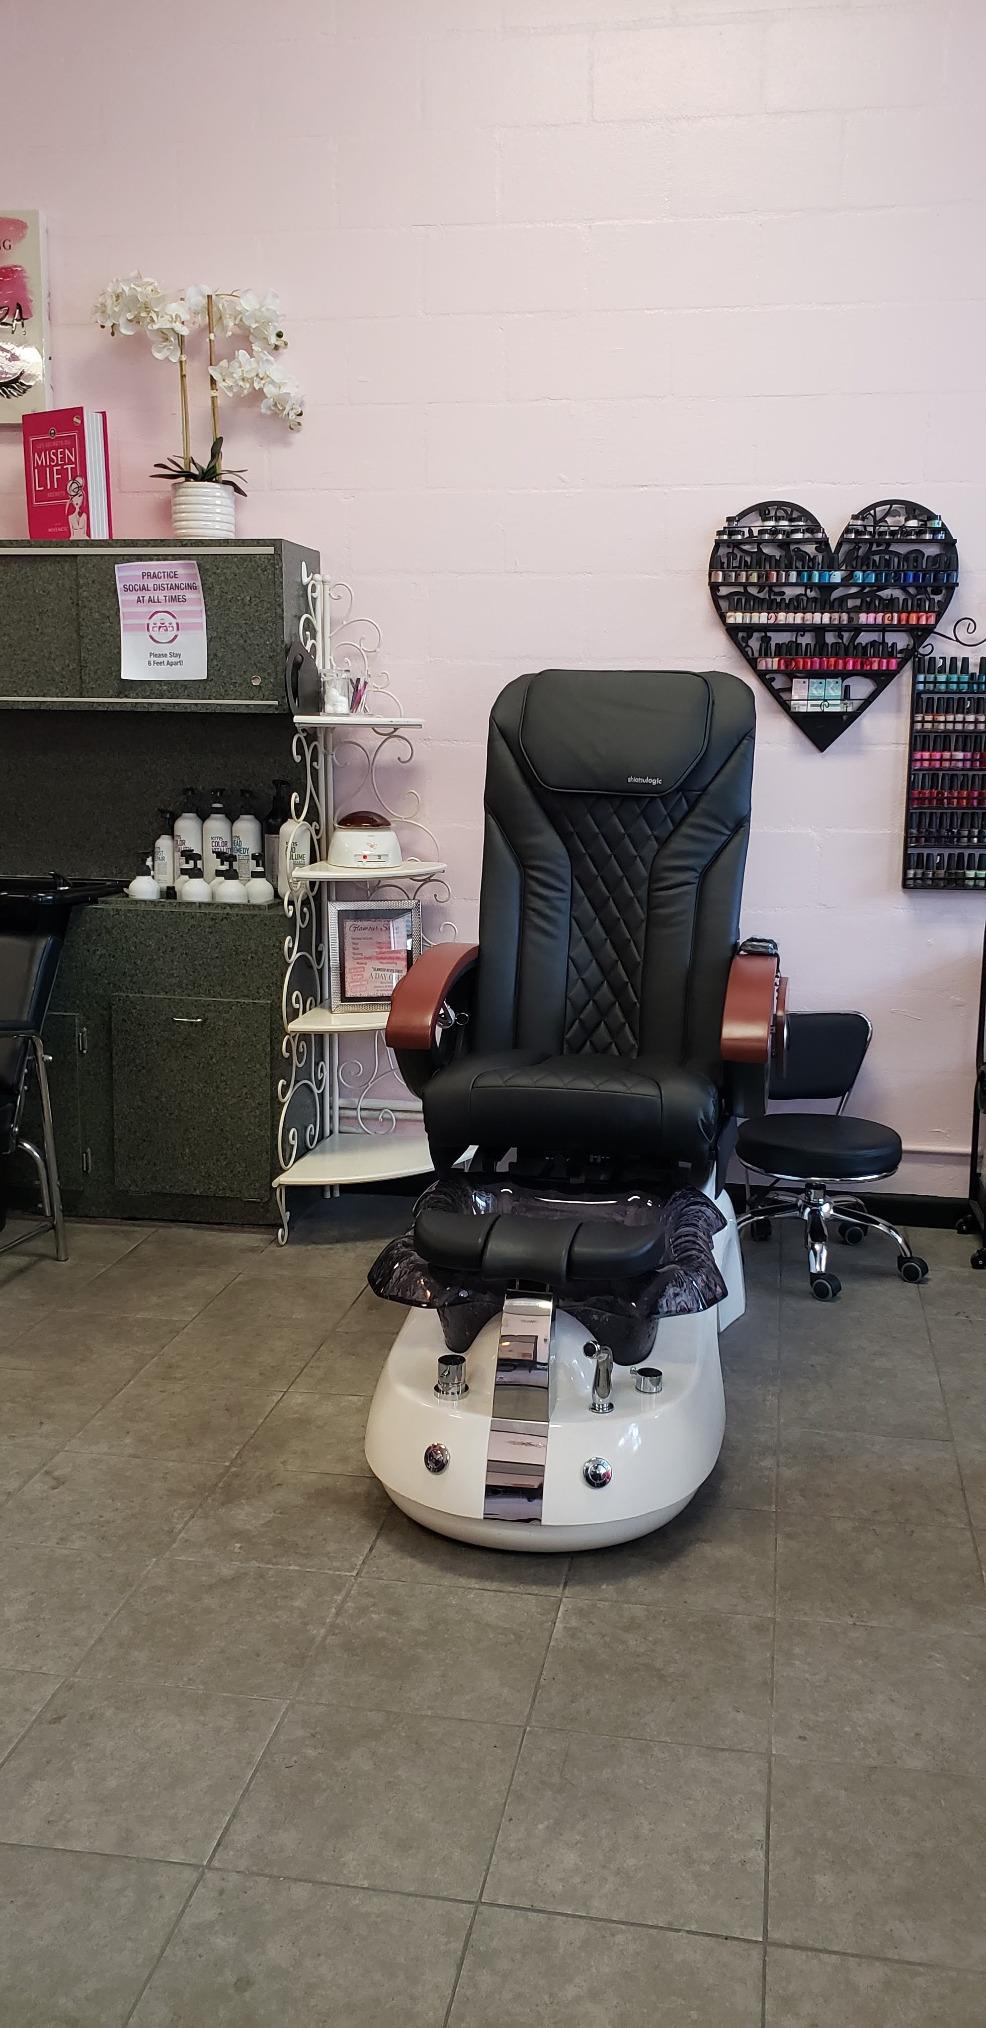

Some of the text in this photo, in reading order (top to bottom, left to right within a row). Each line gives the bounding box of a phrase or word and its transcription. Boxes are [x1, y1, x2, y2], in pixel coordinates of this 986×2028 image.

[34, 447, 75, 467] MISEN
[34, 465, 76, 491] LIFT
[141, 571, 179, 580] PRACTICE
[123, 582, 198, 592] SOCIAL DISTANCING
[136, 595, 187, 604] AT ALL TIMES
[211, 840, 229, 848] COLOR
